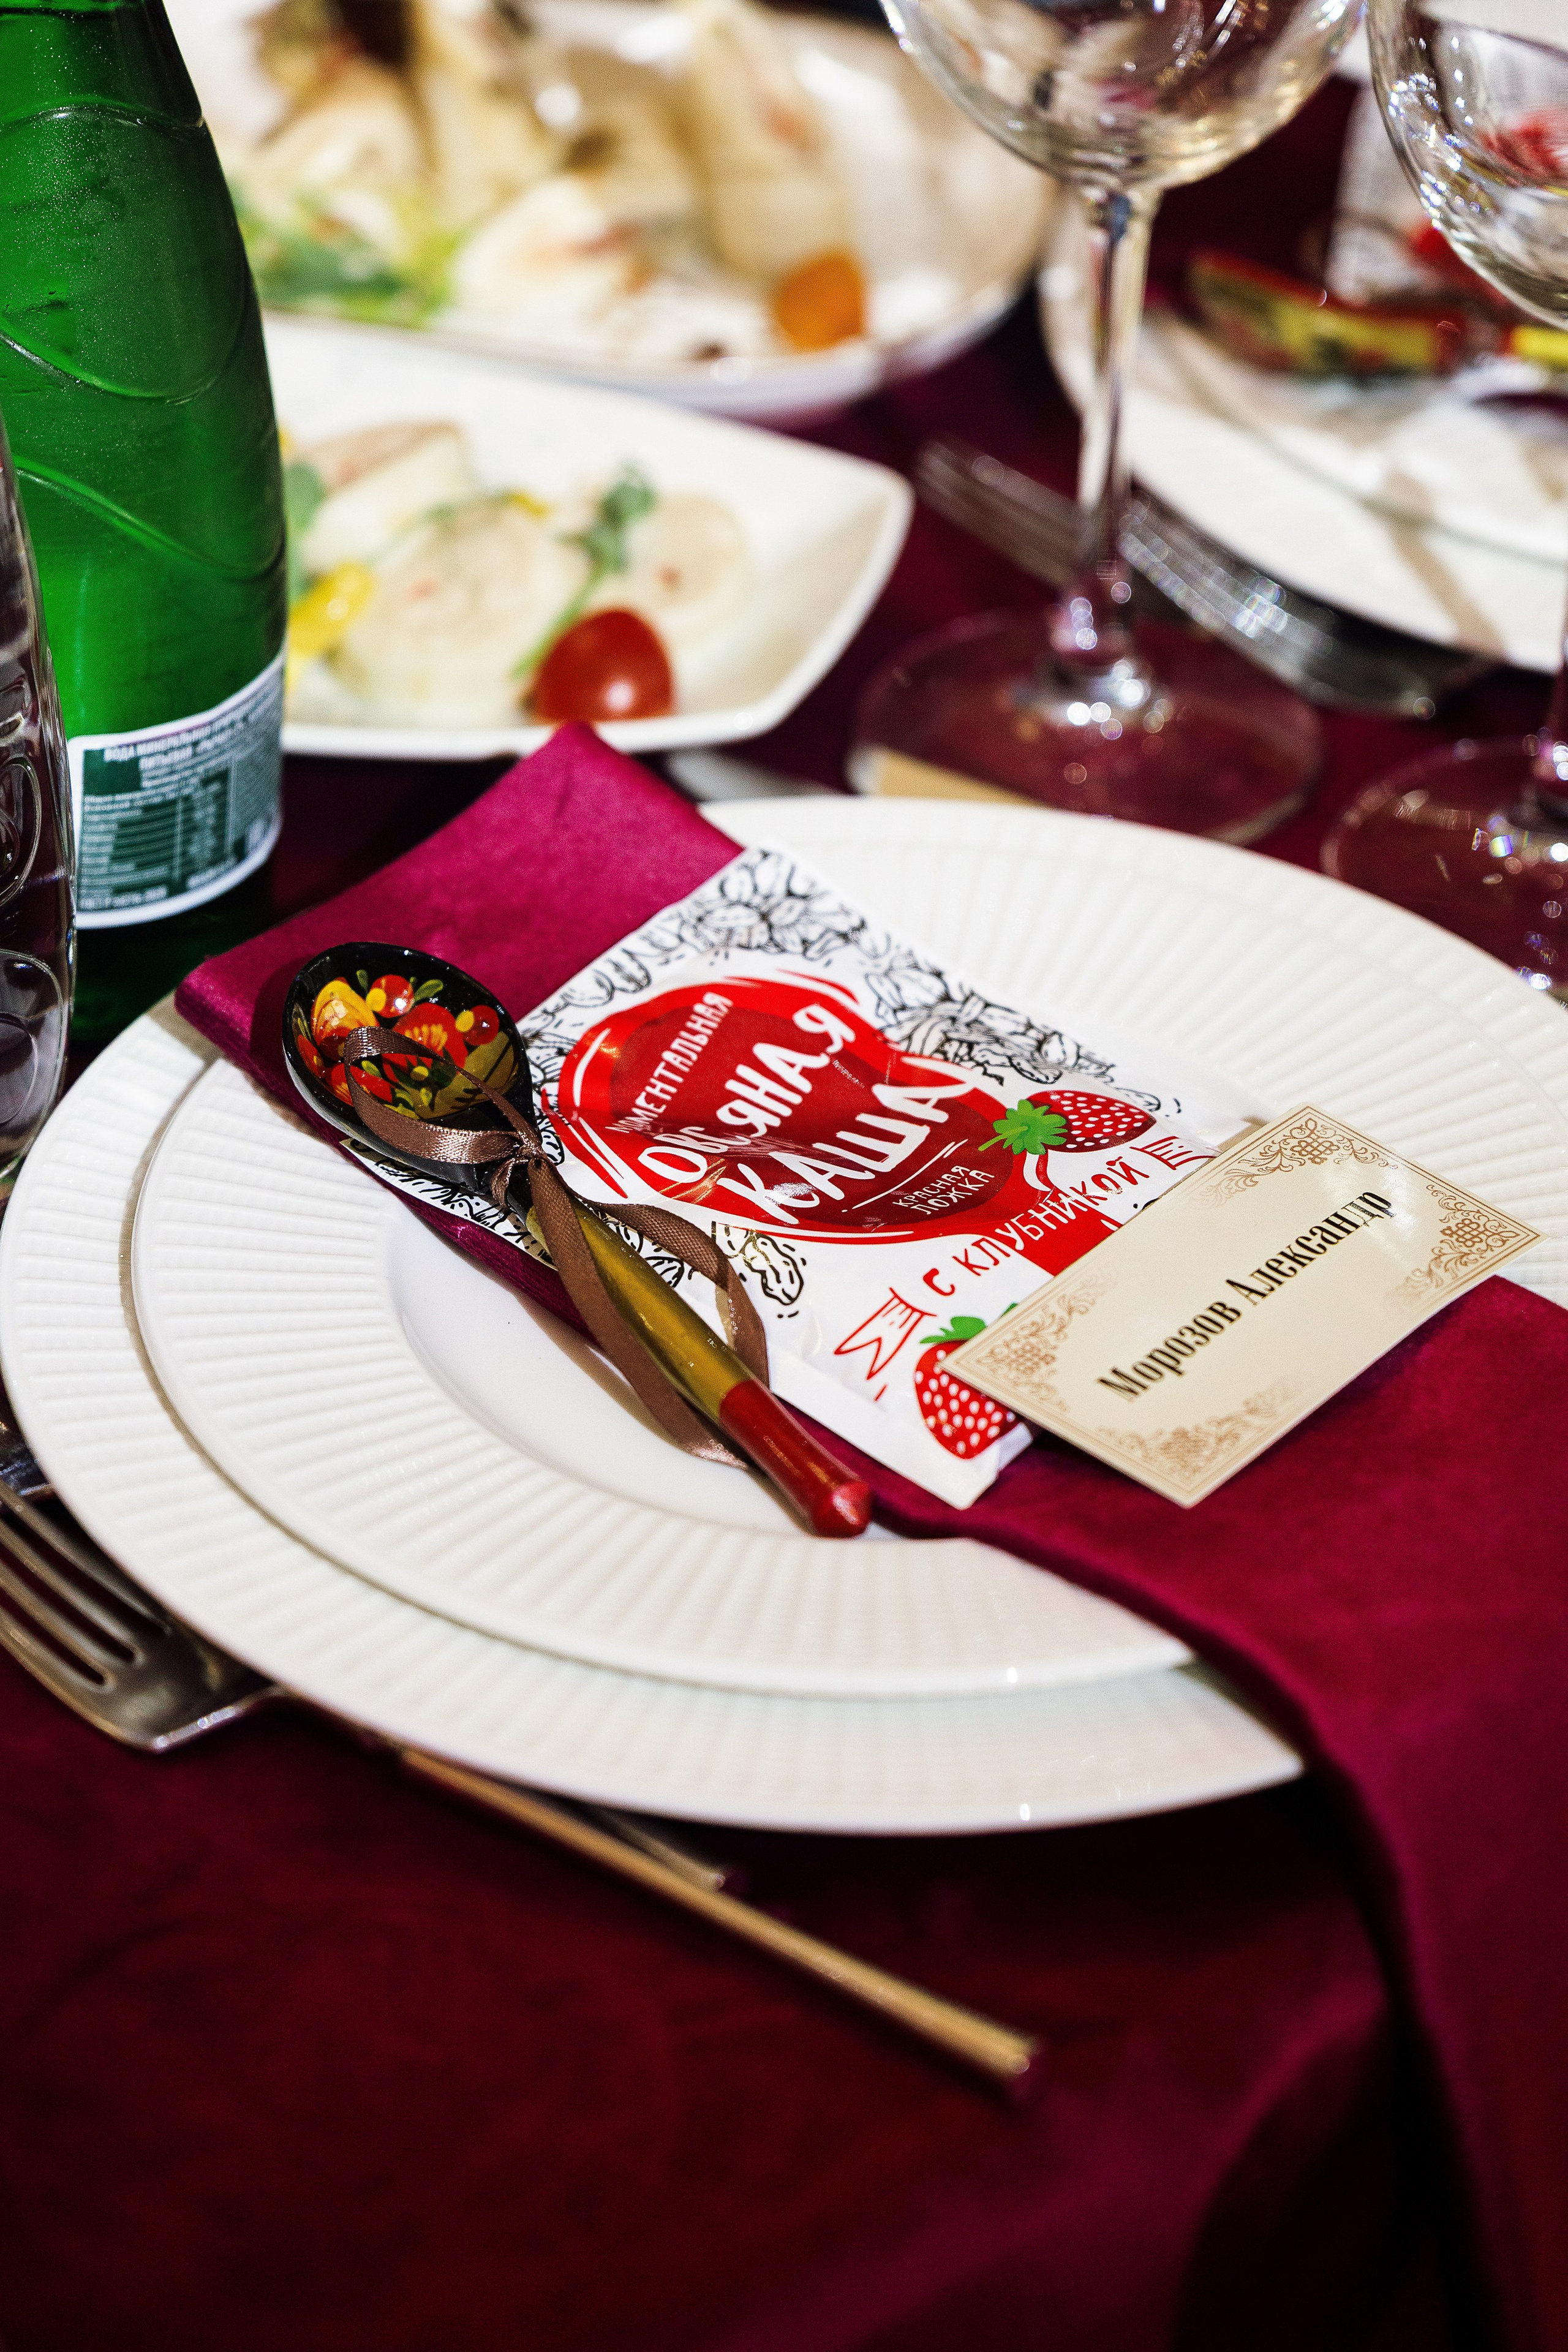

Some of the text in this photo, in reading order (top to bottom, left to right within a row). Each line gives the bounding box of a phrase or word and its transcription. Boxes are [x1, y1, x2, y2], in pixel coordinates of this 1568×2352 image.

[605, 992, 734, 1133] МОМЕНТАЛЬНАЯ
[638, 1003, 857, 1183] ОВСЯНАЯ
[716, 1083, 974, 1224] КАША
[892, 1165, 970, 1207] КРАСНАЯ
[910, 1169, 995, 1215] ЛОЖКА
[952, 1156, 1150, 1276] КЛУБНИКОЙ
[1096, 1191, 1396, 1403] Морозов Александр
